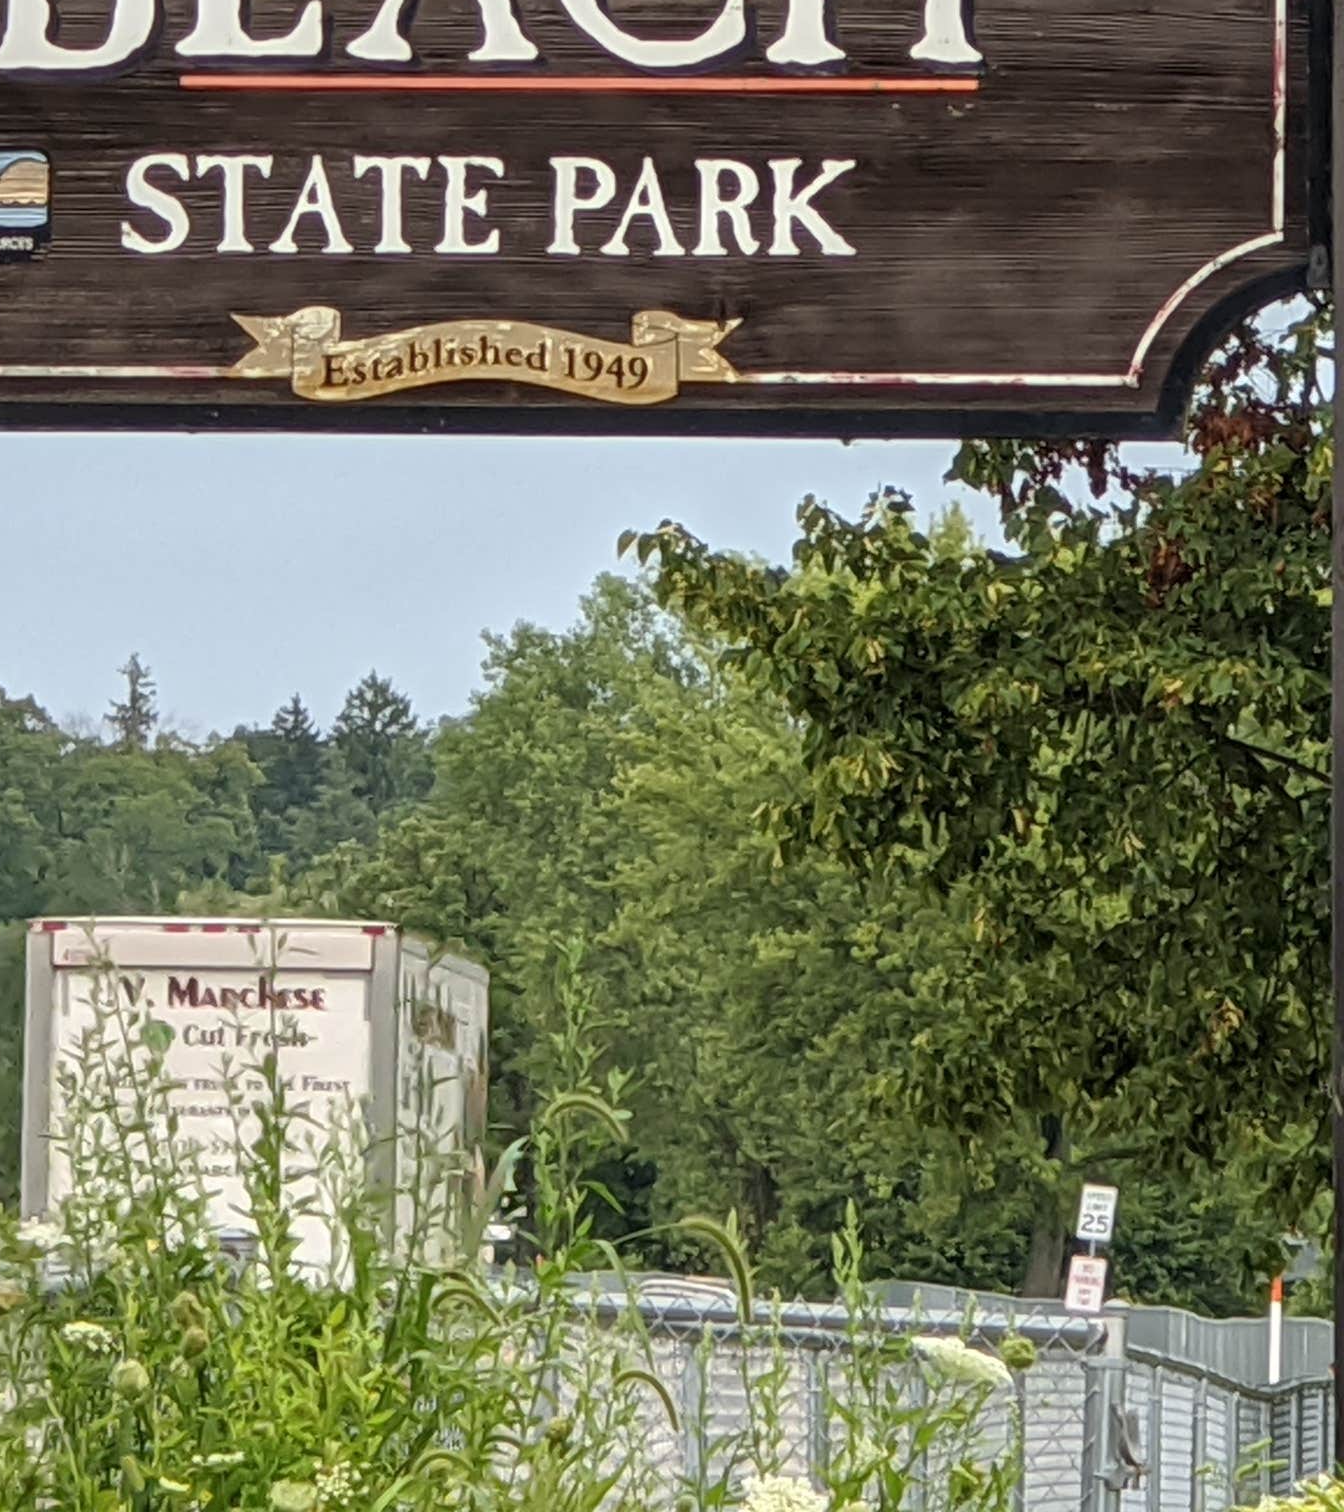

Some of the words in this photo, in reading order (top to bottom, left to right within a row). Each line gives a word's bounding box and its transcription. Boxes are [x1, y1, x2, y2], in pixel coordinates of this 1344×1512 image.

[120, 153, 504, 255] STATE
[546, 155, 857, 256] PARK
[321, 336, 549, 388] Established
[563, 345, 650, 390] 1949
[119, 975, 155, 1008] V.
[182, 1023, 225, 1048] Cut
[1080, 1213, 1110, 1235] 25
